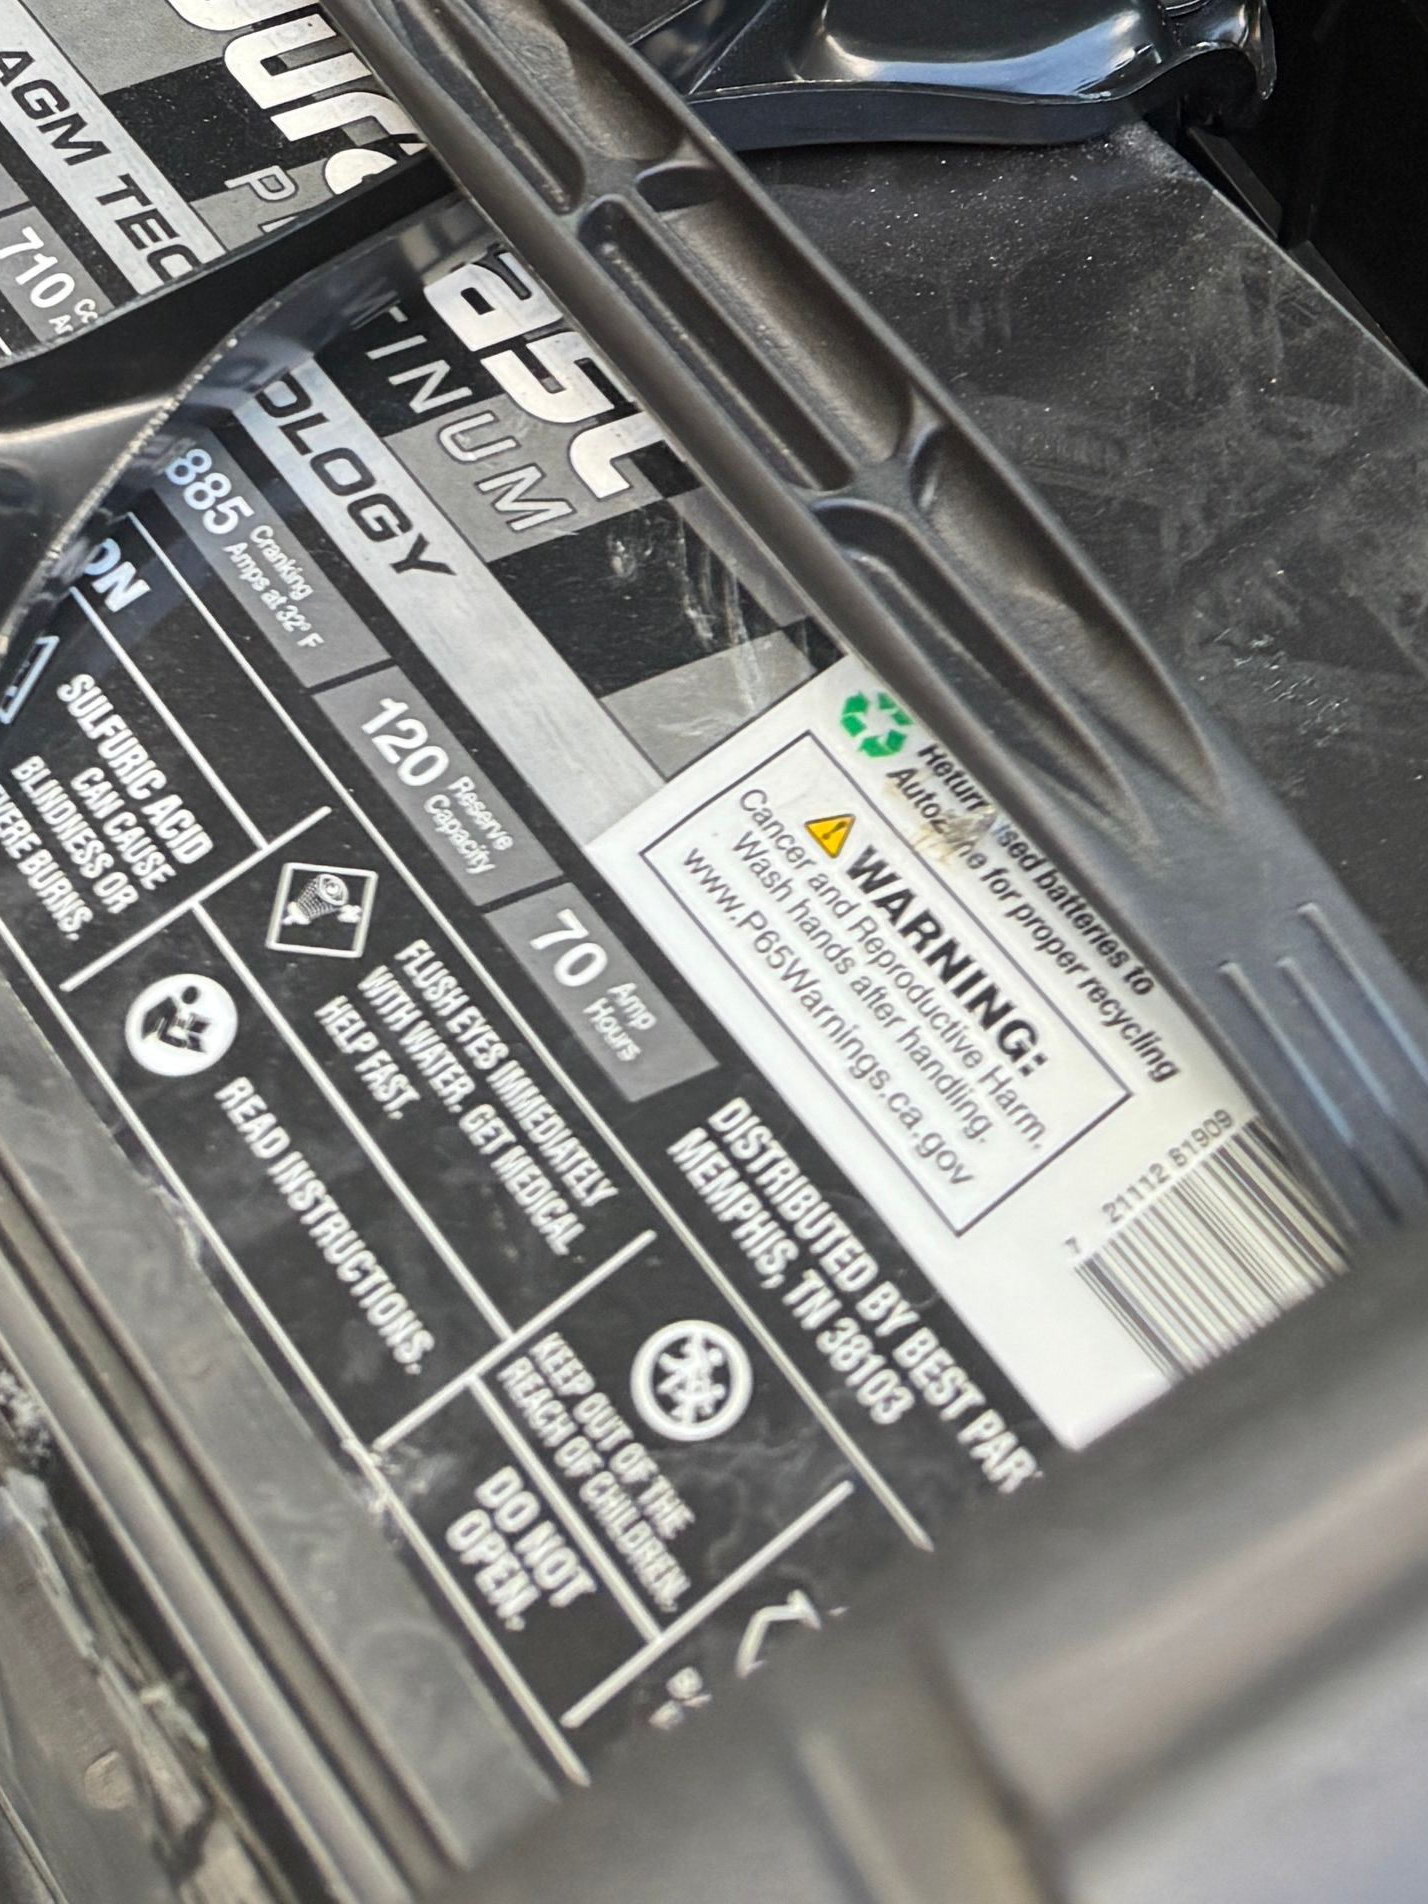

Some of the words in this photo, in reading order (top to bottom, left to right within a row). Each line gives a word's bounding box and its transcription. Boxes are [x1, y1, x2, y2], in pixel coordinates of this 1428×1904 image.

[165, 448, 255, 535] 885
[222, 541, 271, 592] Amps
[259, 588, 288, 611] at
[296, 631, 324, 647] F
[249, 524, 314, 601] Cranking
[56, 673, 167, 800] SULFURIC
[140, 793, 213, 864] ACID
[360, 697, 449, 787] 120
[11, 754, 115, 879] BLINDNESS
[92, 870, 139, 914] OR
[70, 766, 125, 819] CAN
[102, 810, 176, 890] CAUSE
[423, 793, 496, 874] Capacity
[446, 774, 513, 851] Reserve
[528, 907, 608, 987] 70
[731, 829, 793, 903] Wash
[785, 897, 856, 975] hands
[848, 974, 907, 1029] after
[738, 787, 817, 870] Cancer
[806, 871, 861, 920] and
[846, 914, 984, 1070] Reproductive
[845, 844, 1046, 1077] WARNING:
[979, 866, 1023, 901] for
[1003, 902, 1090, 975] proper
[1076, 975, 1180, 1083] recycling
[1032, 864, 1137, 969] batteries
[1122, 965, 1155, 996] to
[314, 994, 379, 1054] HELP
[582, 996, 641, 1061] Hours
[606, 981, 656, 1030] Amp
[681, 846, 974, 1185] www.P65Warnings.ca.gov
[215, 1076, 290, 1159] READ
[357, 964, 422, 1031] WITH
[458, 1103, 516, 1154] GET
[490, 1144, 584, 1254] MEDICAL
[394, 938, 470, 1017] FLUSH
[445, 1005, 509, 1070] EYES
[486, 1059, 618, 1206] IMMEDIATELY
[666, 1126, 799, 1289] MEMPHIS,
[782, 1268, 841, 1329] TN
[816, 1316, 914, 1424] 38103
[707, 1096, 878, 1292] DISTRIBUTED
[855, 1280, 919, 1336] BY
[892, 1326, 984, 1420] BEST
[498, 1355, 575, 1446] REACH
[554, 1435, 603, 1477] OF
[529, 1331, 595, 1395] KEEP
[572, 1391, 632, 1450] OUT
[609, 1441, 658, 1483] OF
[637, 1474, 693, 1537] THE
[475, 1465, 539, 1532] DO
[514, 1520, 595, 1606] NOT
